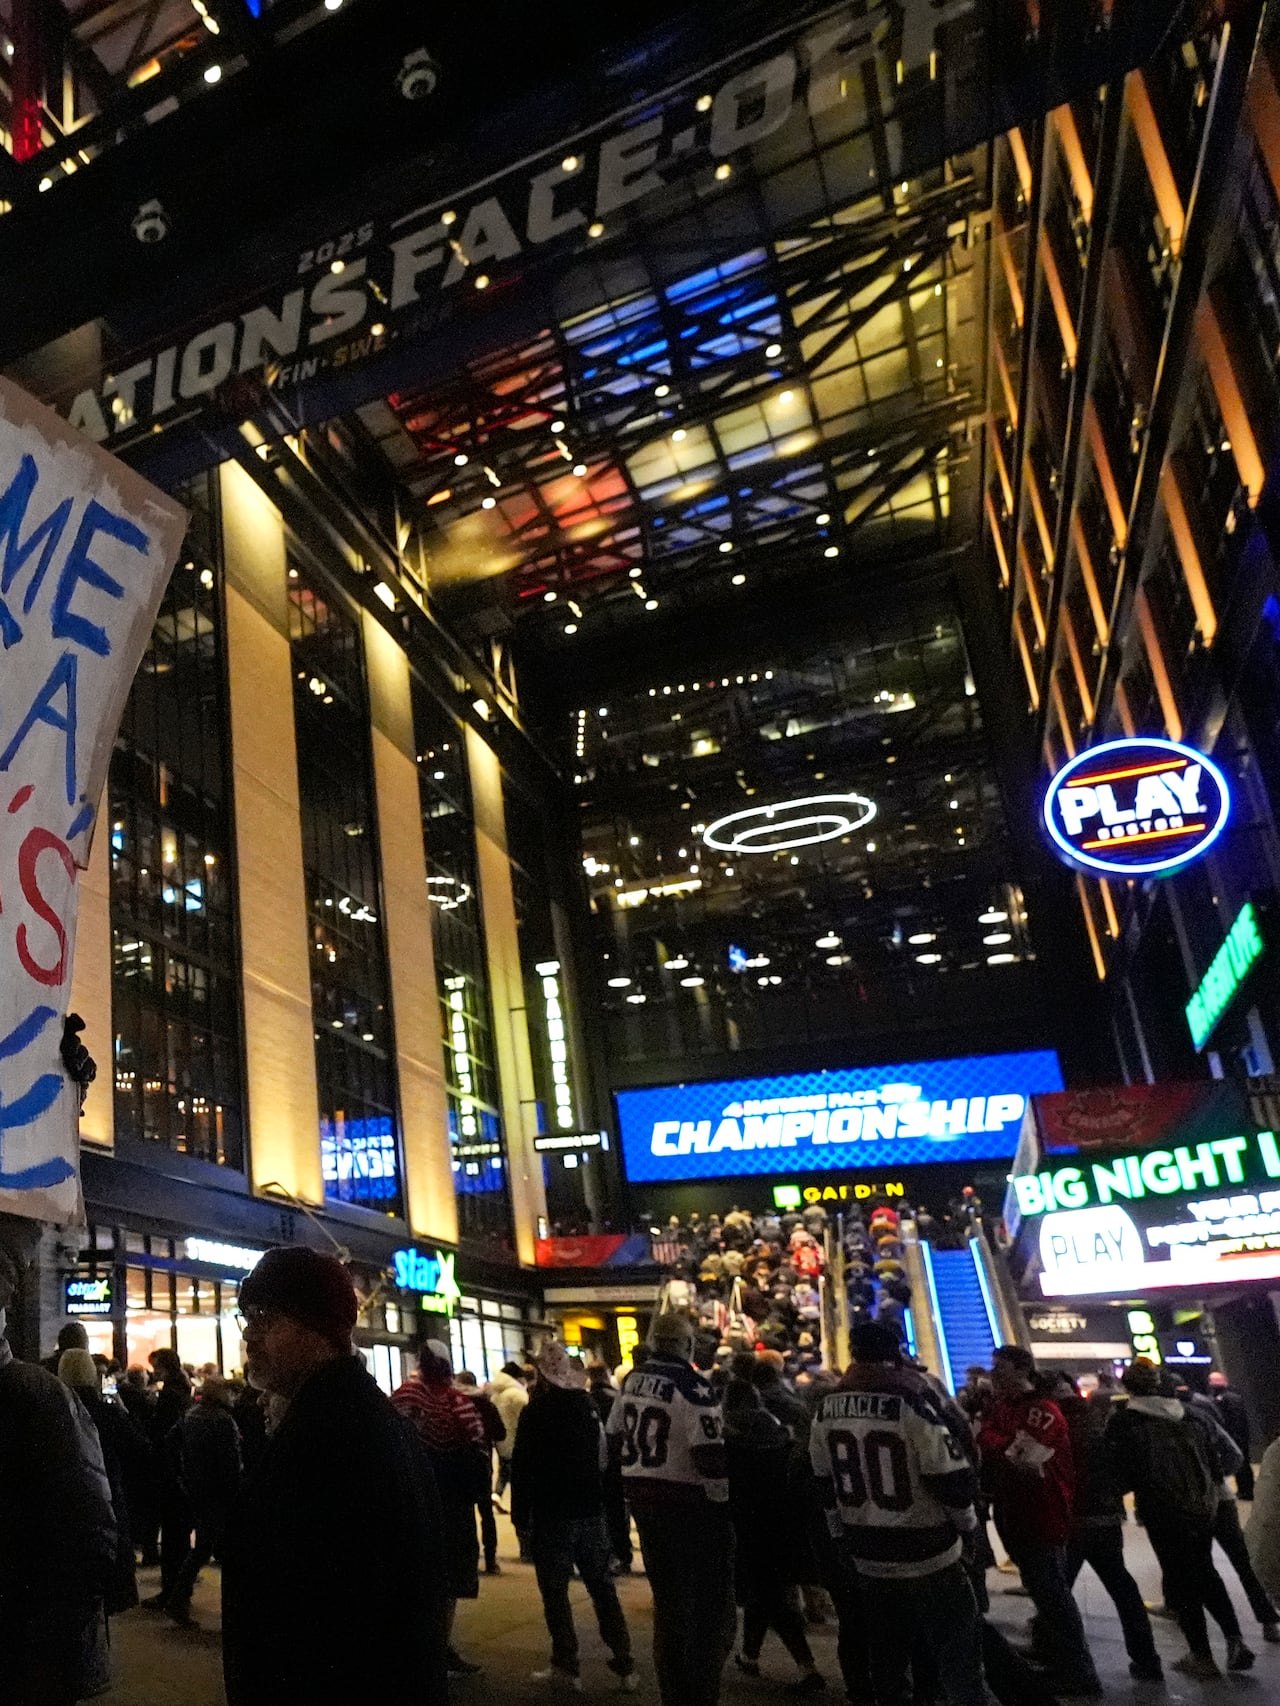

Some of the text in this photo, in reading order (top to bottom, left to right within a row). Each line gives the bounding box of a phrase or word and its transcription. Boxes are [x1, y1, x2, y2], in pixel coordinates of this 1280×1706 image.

[297, 222, 375, 274] 2025
[67, 257, 368, 443] ATIONS
[1057, 764, 1202, 836] PLAY
[651, 1093, 1024, 1157] CHAMPIONSHIP
[803, 1182, 904, 1203] GADN
[1014, 1167, 1089, 1216] BIG
[1091, 1136, 1247, 1204] NIGHT
[822, 1395, 891, 1418] MIRACLE
[1026, 1407, 1056, 1431] 87
[827, 1429, 915, 1512] 80
